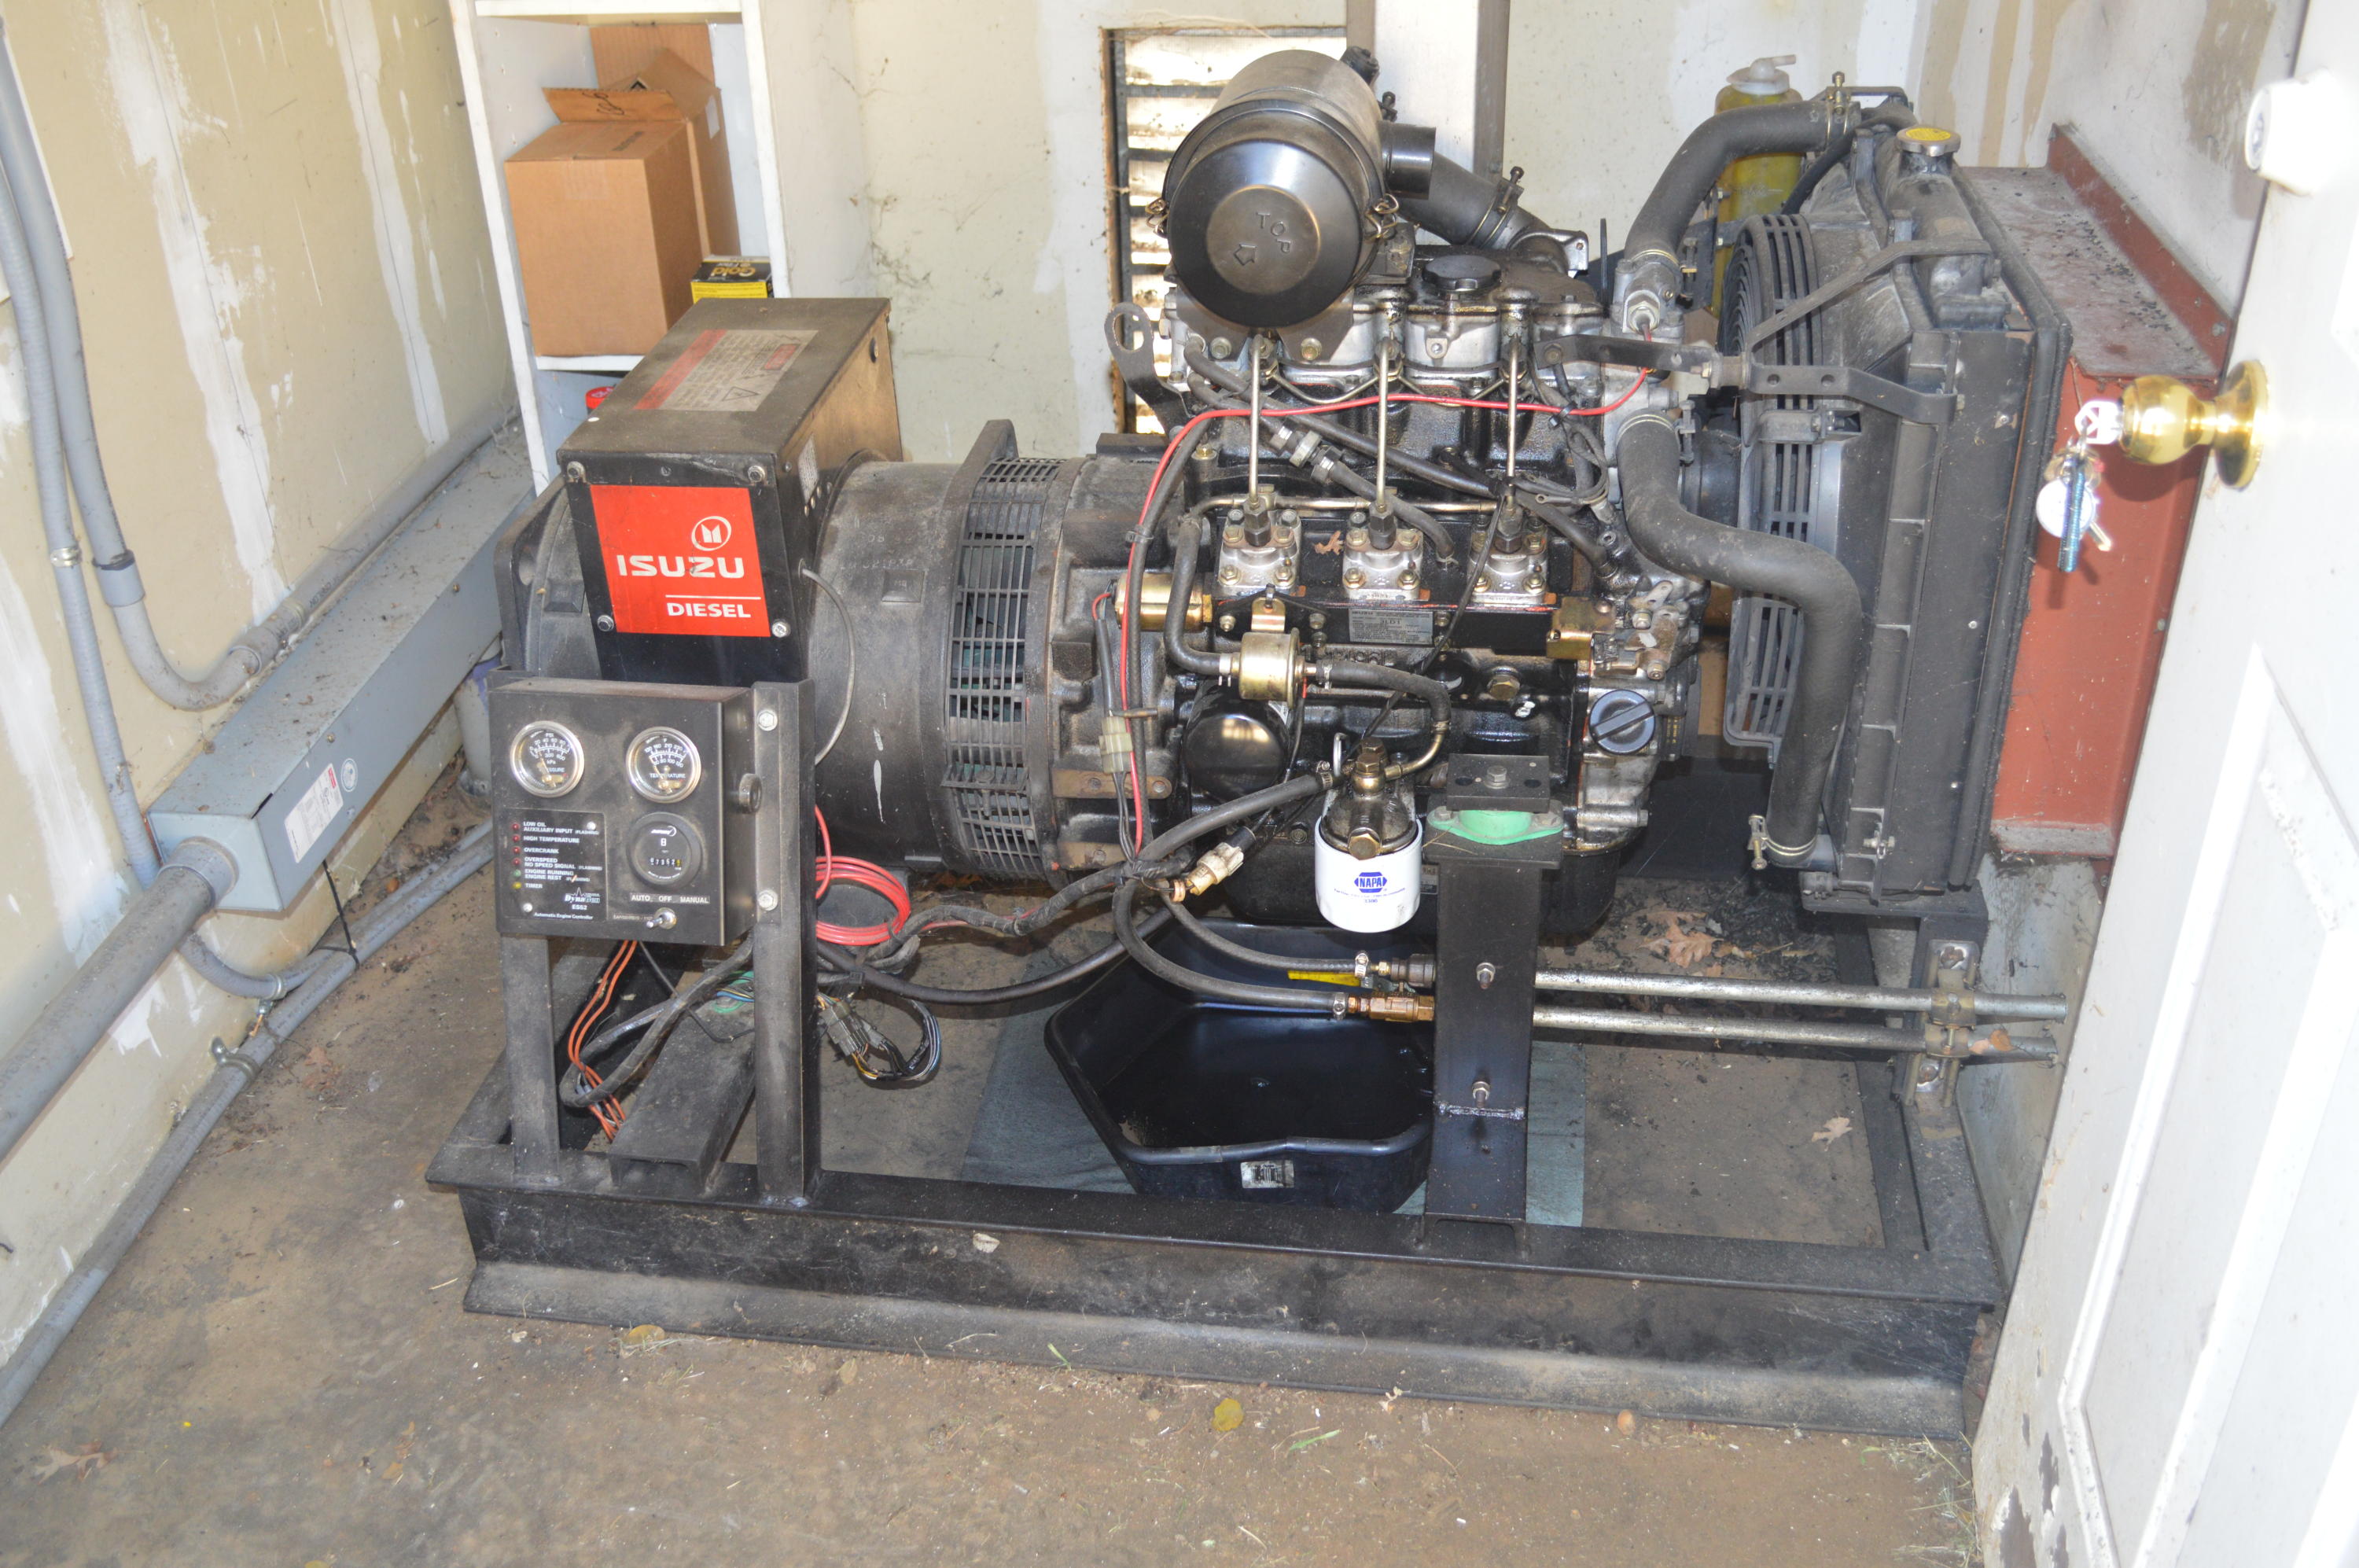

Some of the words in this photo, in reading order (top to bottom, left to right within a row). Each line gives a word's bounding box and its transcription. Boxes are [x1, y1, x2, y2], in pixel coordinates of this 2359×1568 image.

[1256, 212, 1291, 254] TOP
[710, 266, 756, 278] Gold
[616, 554, 745, 579] ISUZU
[666, 602, 752, 618] DIESEL
[1360, 878, 1382, 887] NAPA
